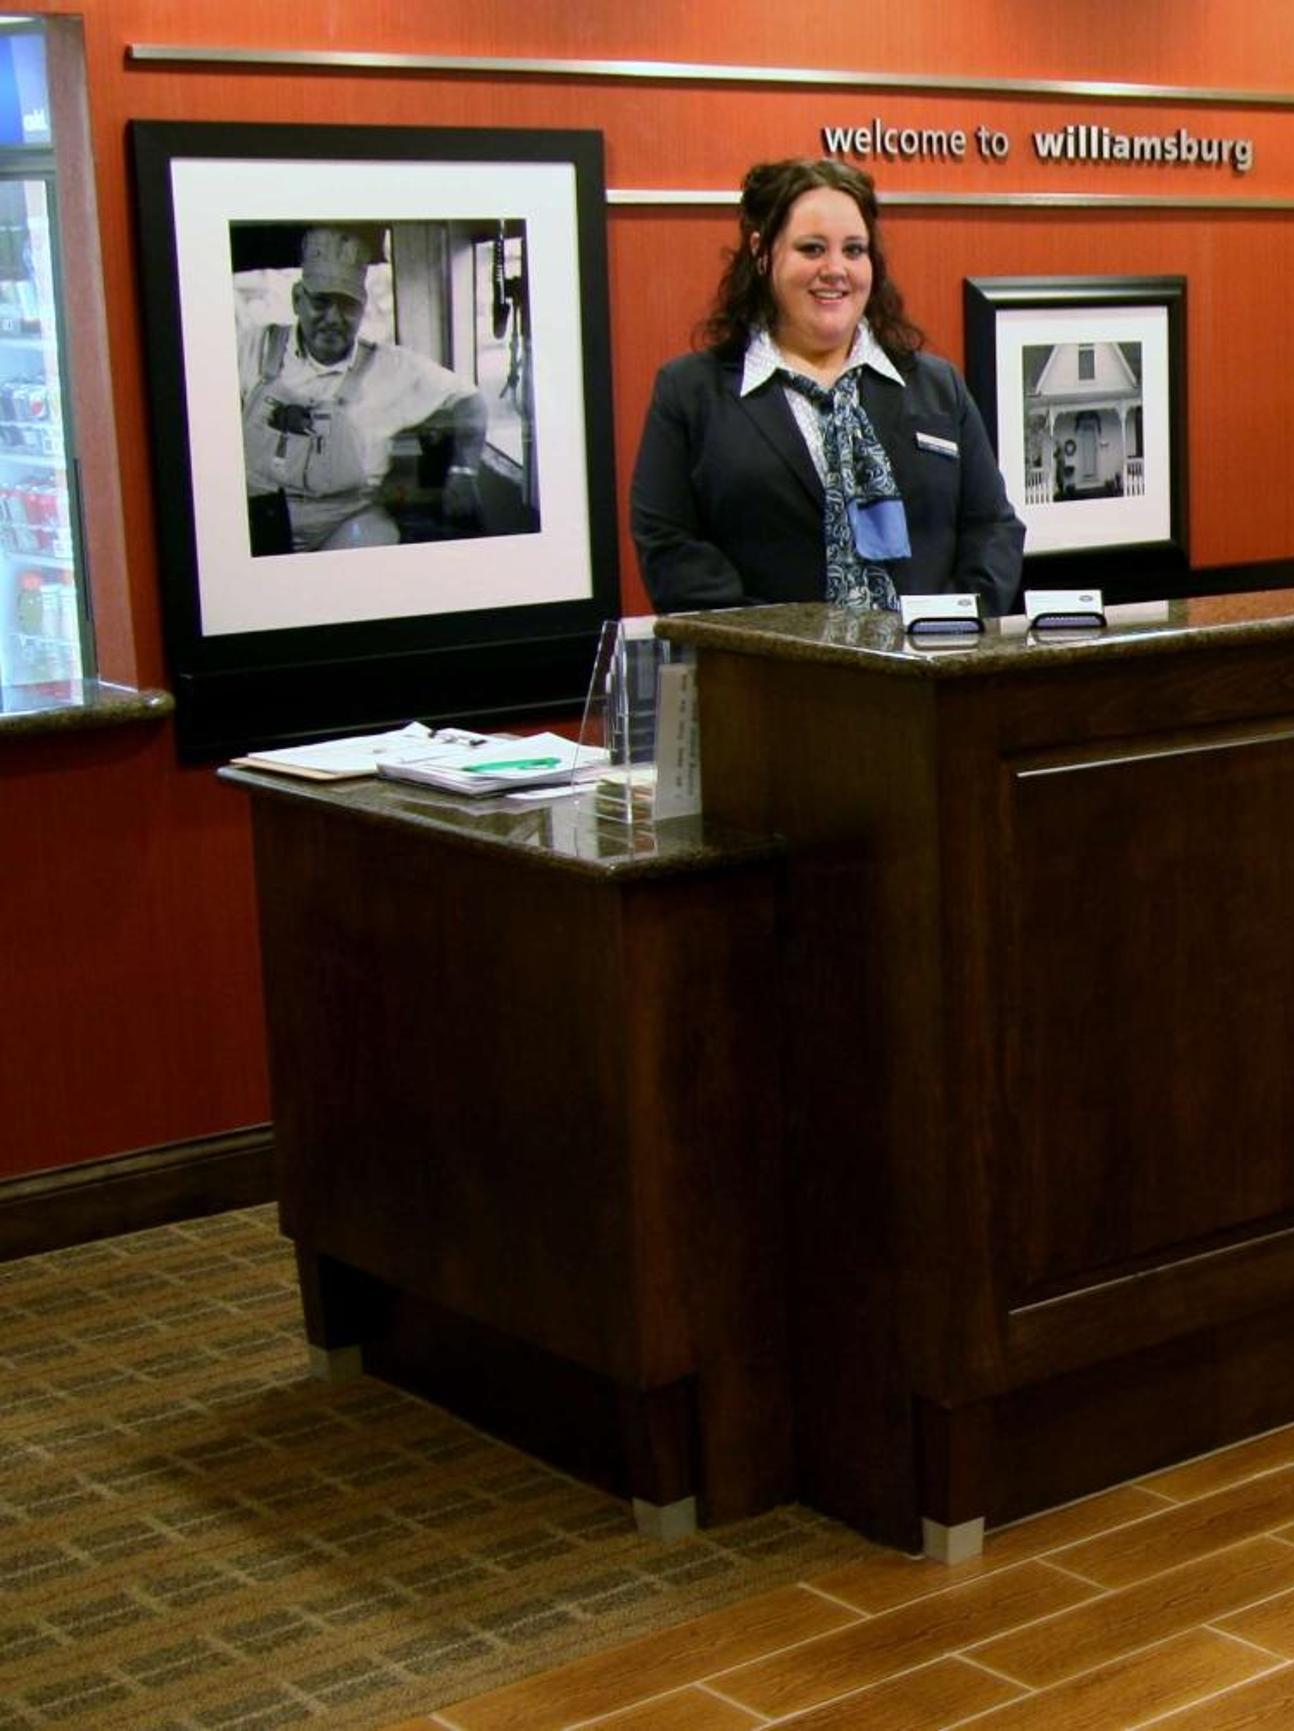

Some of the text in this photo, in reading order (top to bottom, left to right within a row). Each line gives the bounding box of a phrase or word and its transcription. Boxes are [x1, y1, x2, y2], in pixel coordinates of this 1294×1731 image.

[823, 118, 1254, 171] welcome to williamsburg
